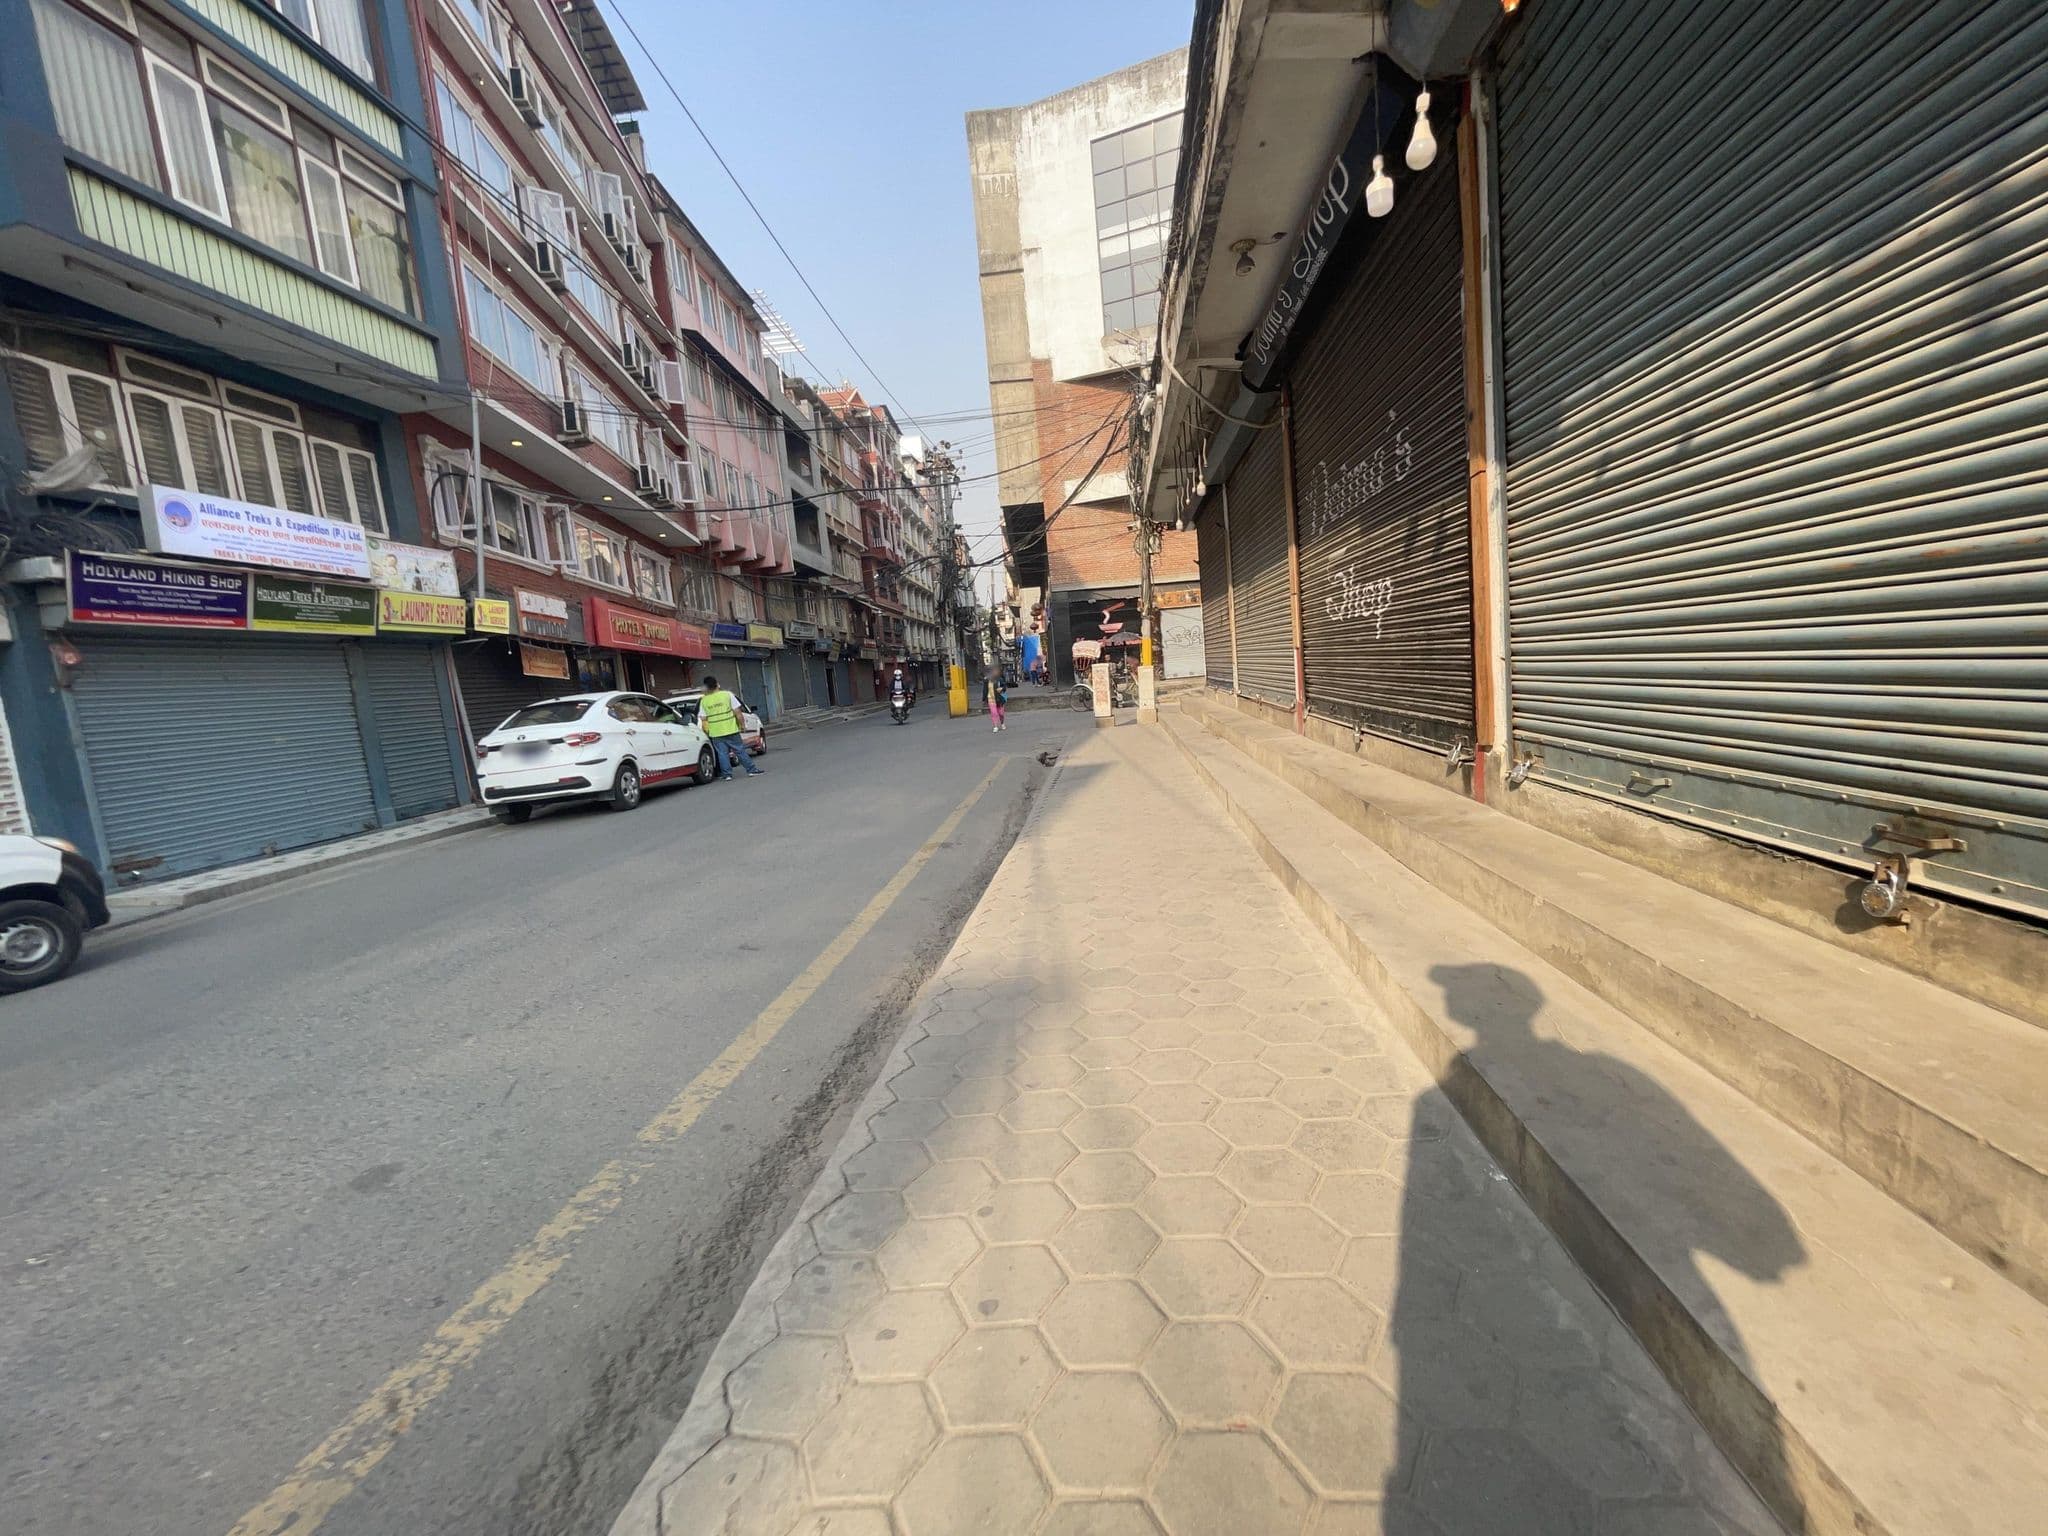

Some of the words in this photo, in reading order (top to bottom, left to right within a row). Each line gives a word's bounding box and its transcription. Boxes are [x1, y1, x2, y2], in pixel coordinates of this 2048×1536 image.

[200, 502, 241, 520] Alliance
[244, 511, 271, 526] Treks
[276, 517, 282, 528] &
[286, 519, 330, 536] Expedition
[82, 560, 157, 582] HOLYLAND
[162, 569, 205, 587] HIKING
[210, 574, 243, 590] SHOP
[400, 600, 433, 624] LAUNDRY
[436, 603, 465, 625] SERVICE
